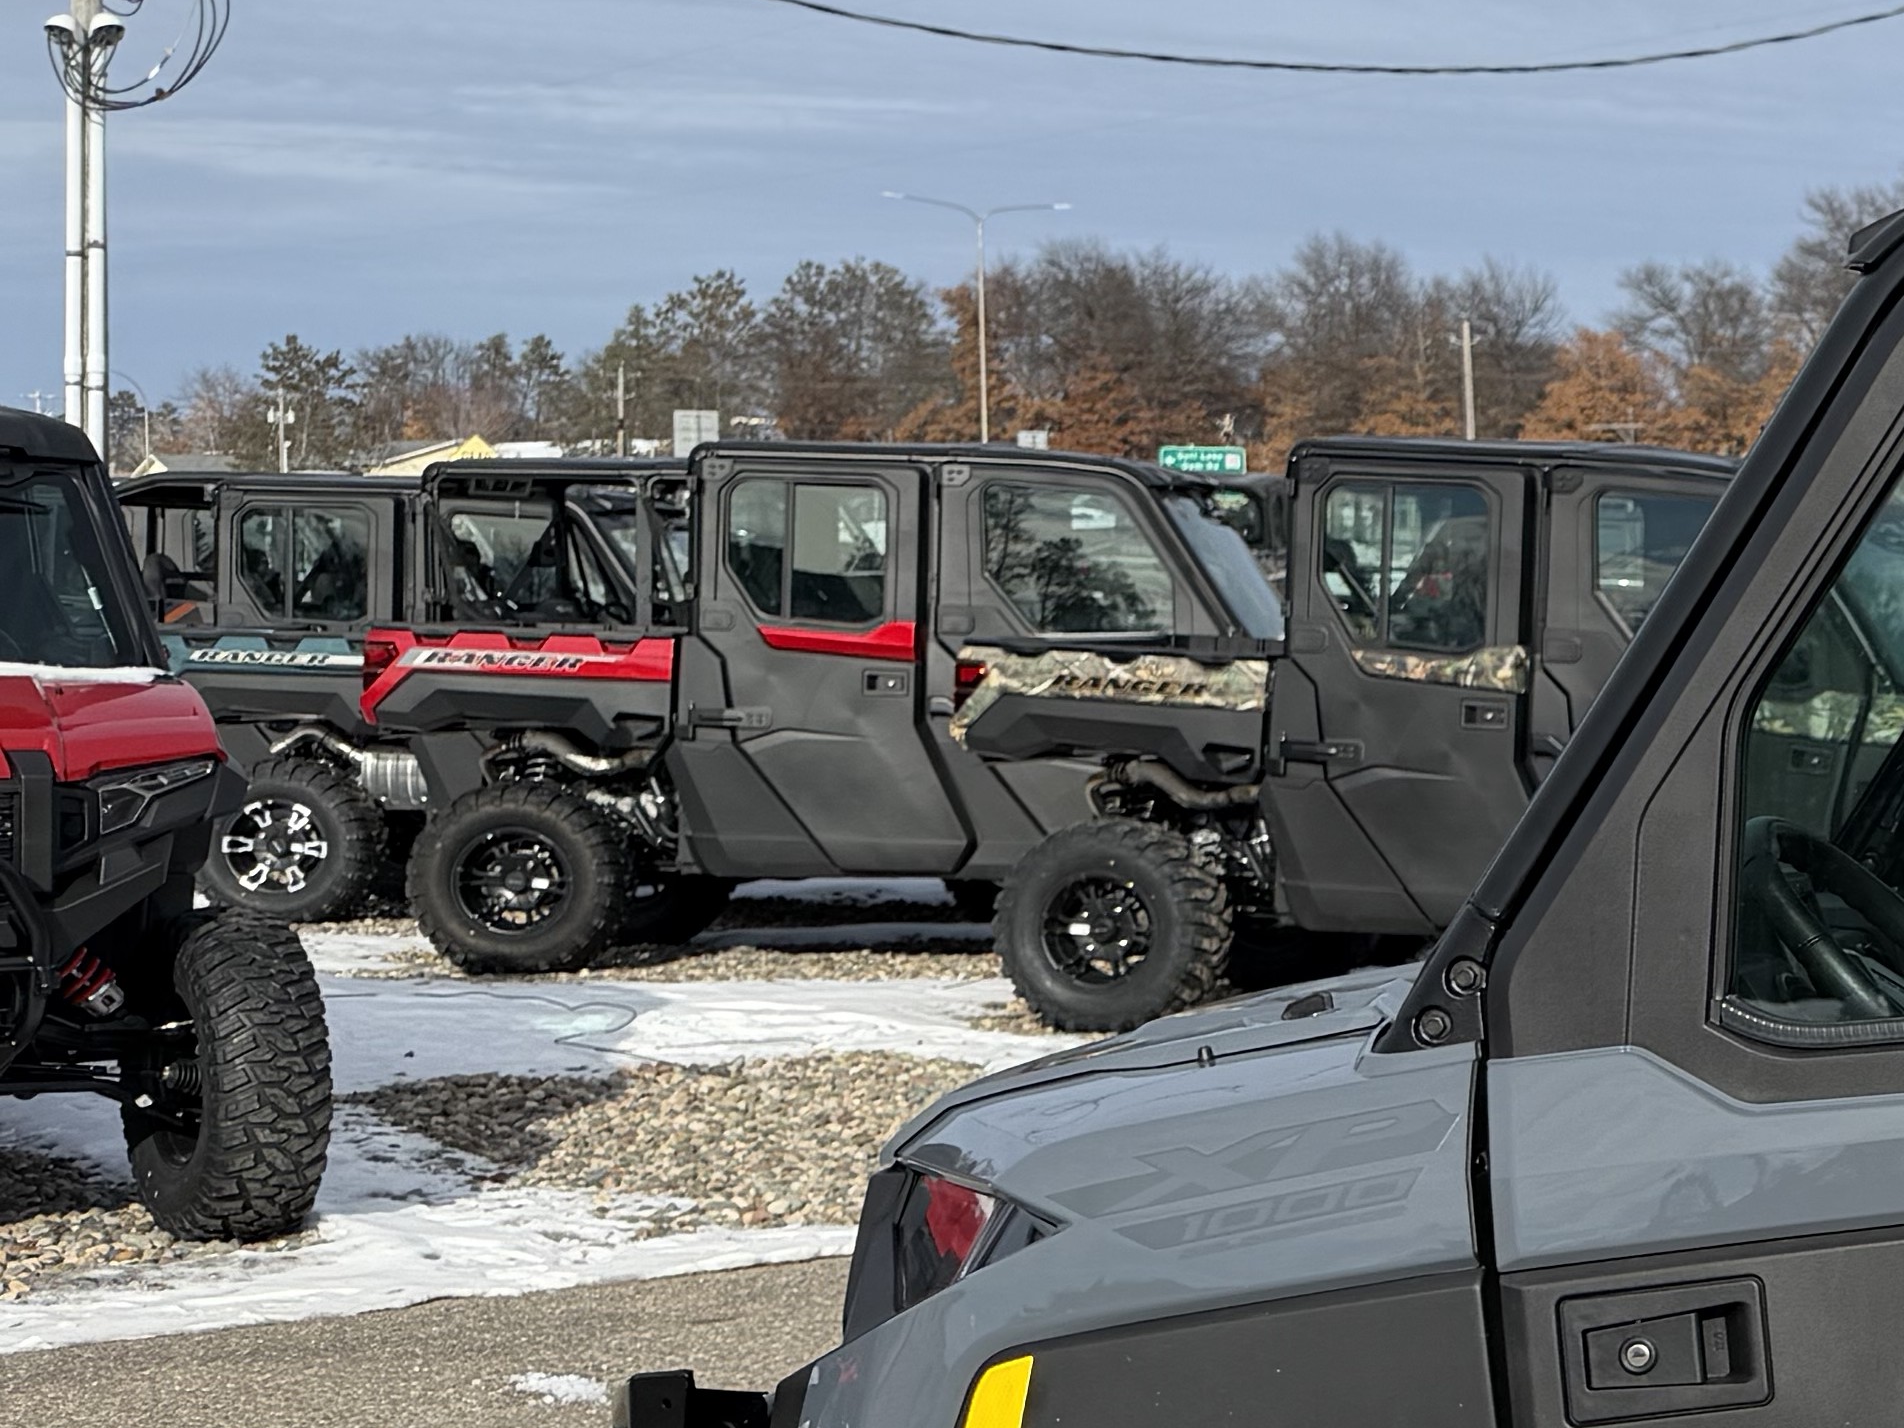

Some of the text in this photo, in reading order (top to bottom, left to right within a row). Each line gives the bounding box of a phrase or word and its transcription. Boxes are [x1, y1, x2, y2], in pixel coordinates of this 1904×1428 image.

[196, 649, 332, 667] RANGER
[423, 649, 585, 672] RANGER
[1050, 674, 1209, 696] RANGER
[1104, 1099, 1460, 1212] XP
[1183, 1176, 1408, 1241] 1000
